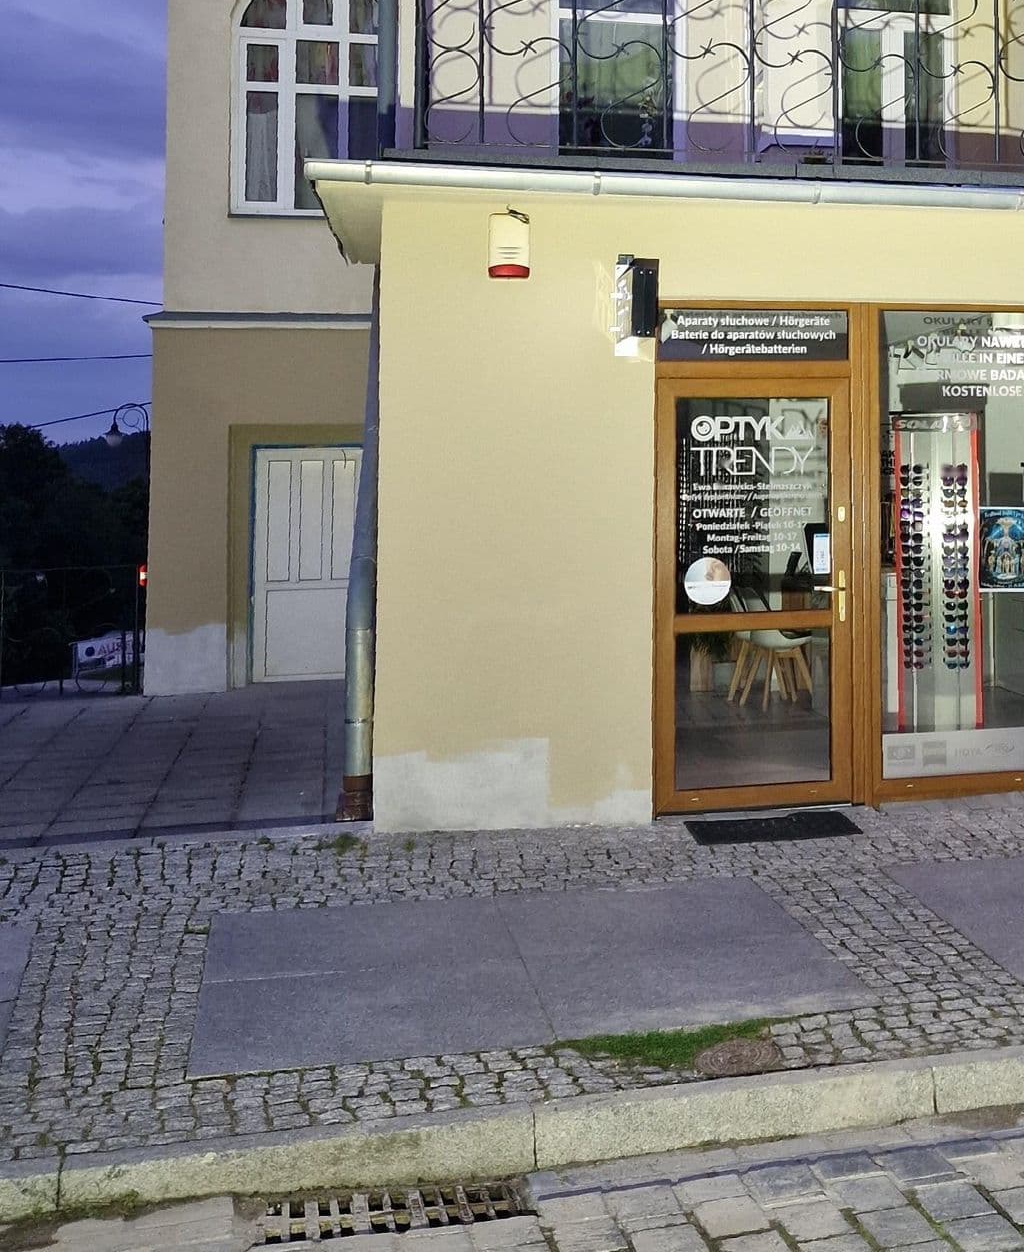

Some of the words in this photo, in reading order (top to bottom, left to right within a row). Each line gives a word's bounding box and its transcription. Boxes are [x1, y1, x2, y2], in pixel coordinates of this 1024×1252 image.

[677, 315, 719, 327] Aparaty
[721, 315, 769, 326] słuchowe
[779, 315, 831, 328] Hörgeräte
[671, 330, 709, 340] Baterie
[711, 330, 725, 340] do
[727, 330, 775, 342] aparatów
[777, 330, 837, 342] słuchowych
[917, 335, 978, 348] OKULARY
[710, 344, 808, 356] Hörgerätebatterien
[979, 352, 994, 364] IN
[941, 385, 1022, 397] KOSTENLOSE
[690, 415, 784, 442] OPTYK
[690, 446, 814, 476] TRENDY
[692, 507, 746, 519] OTWARTE
[702, 544, 733, 554] Sobota
